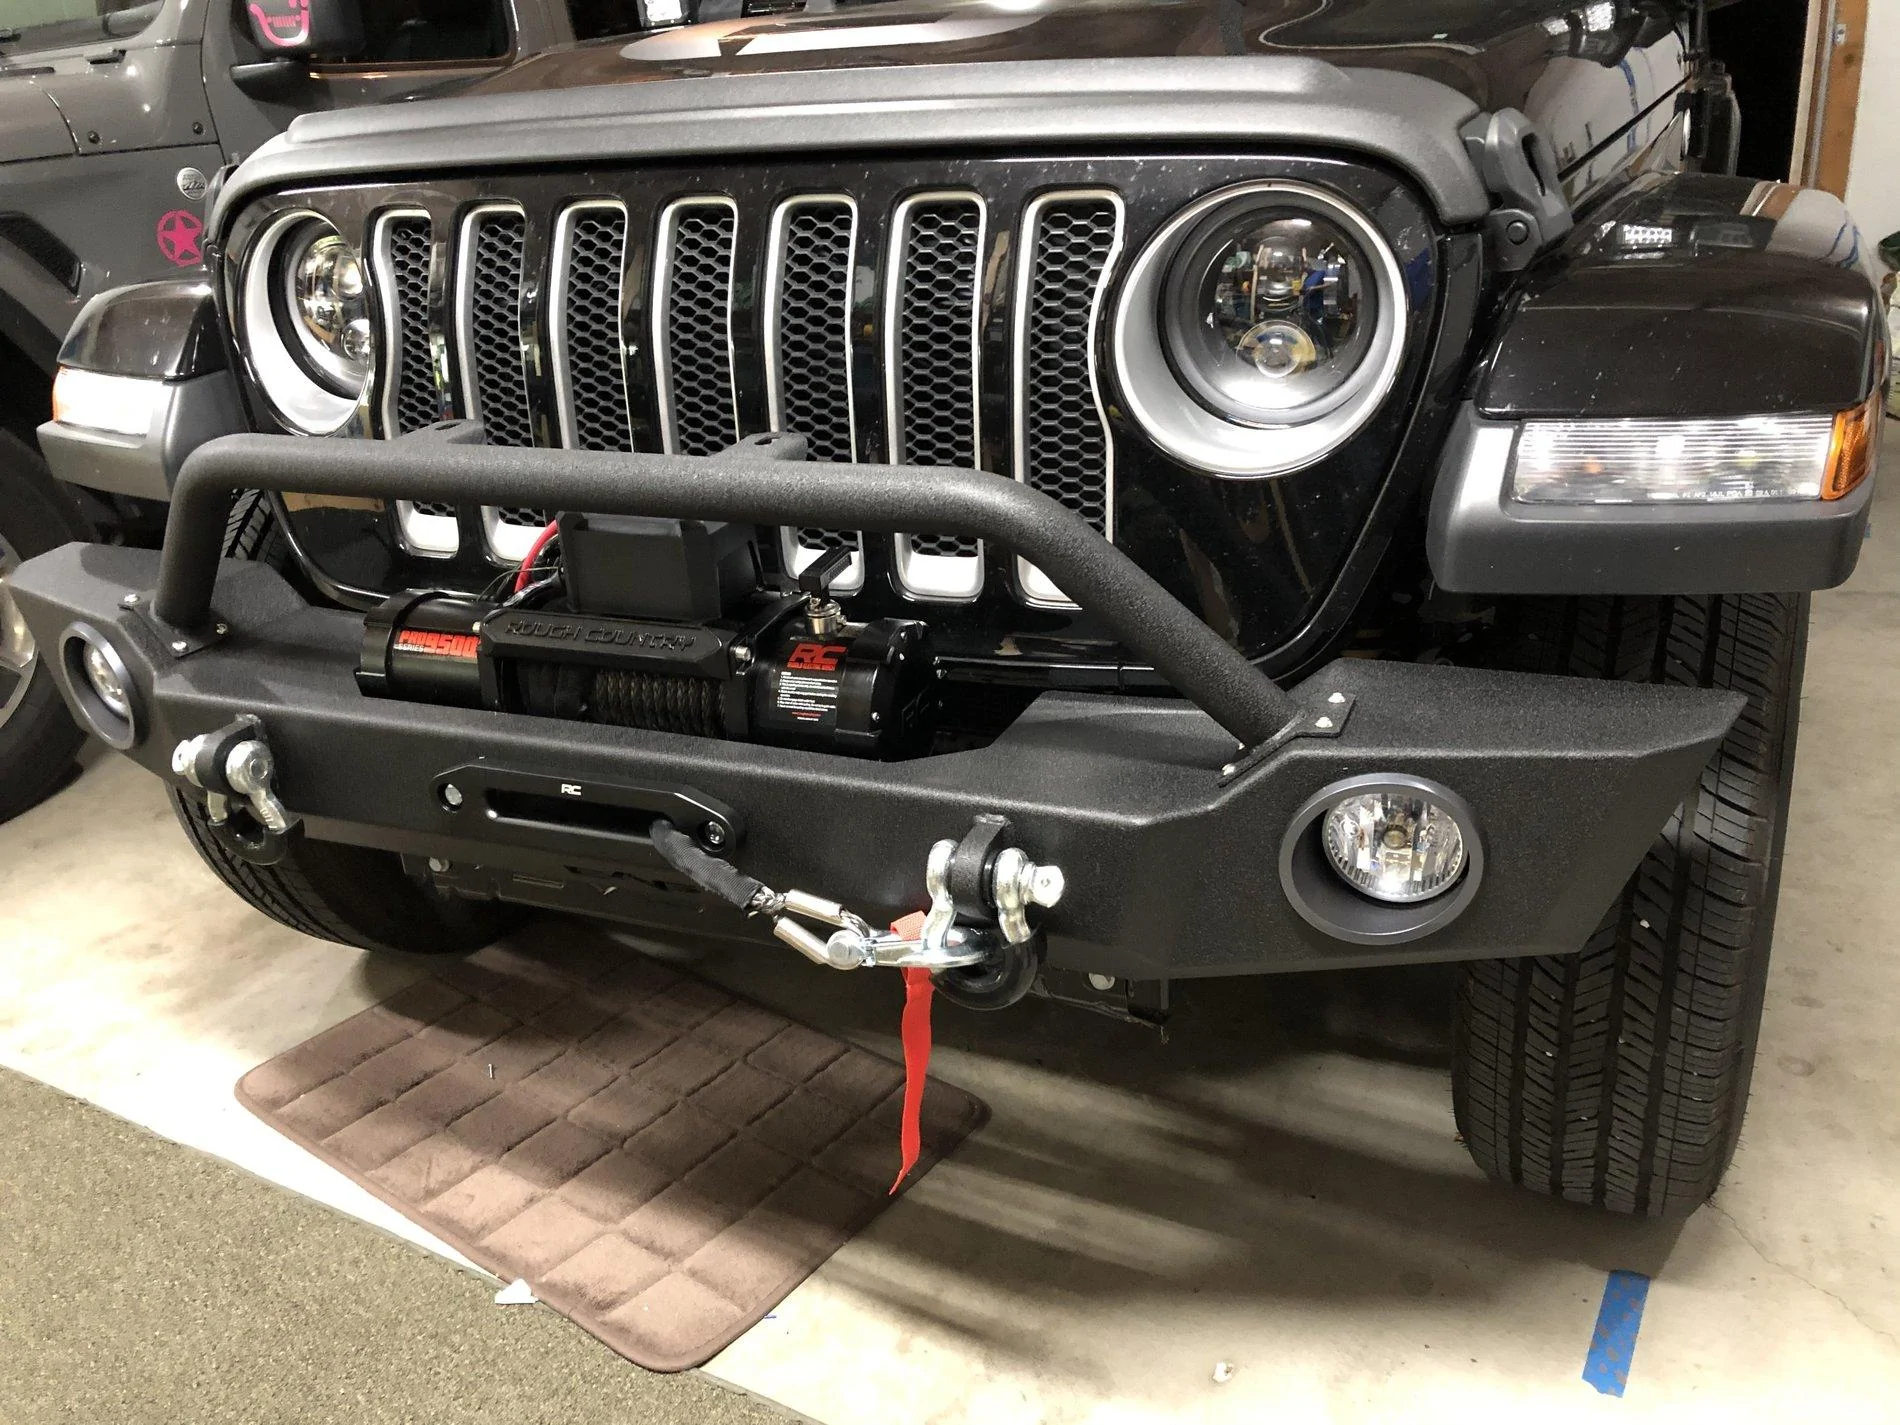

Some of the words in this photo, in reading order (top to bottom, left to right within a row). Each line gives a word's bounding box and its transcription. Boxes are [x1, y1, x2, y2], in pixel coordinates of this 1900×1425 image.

[505, 620, 583, 641] ROUGH
[584, 628, 697, 651] COUNTRY
[788, 643, 848, 665] RC
[561, 783, 582, 796] RC
